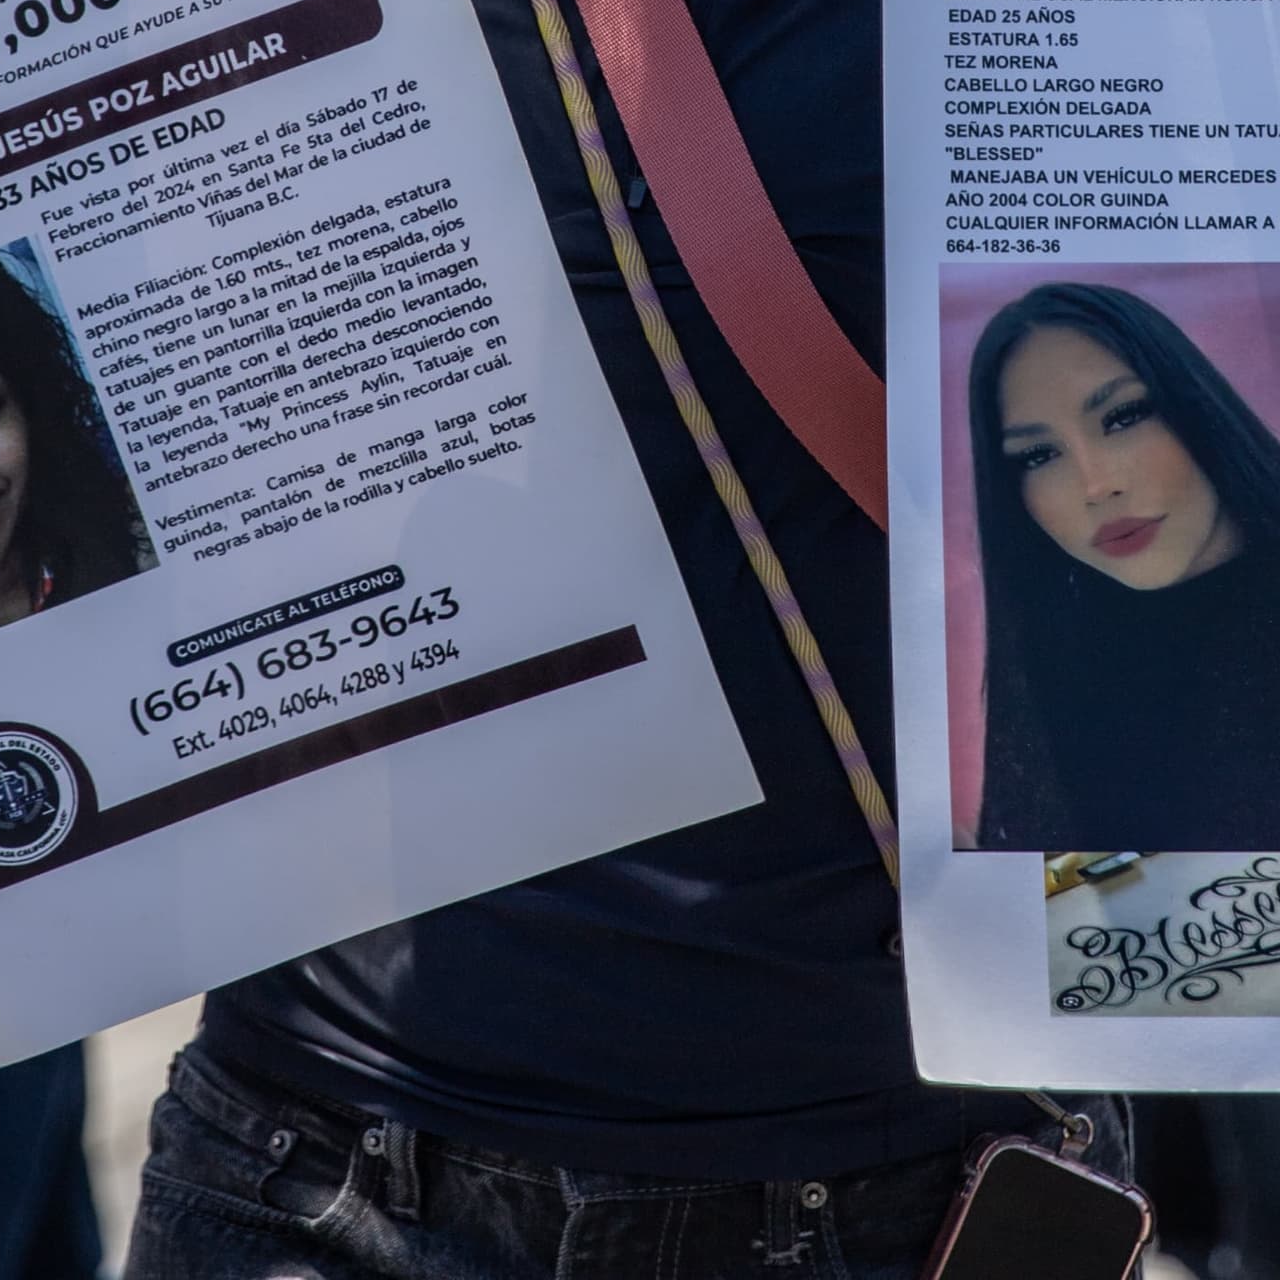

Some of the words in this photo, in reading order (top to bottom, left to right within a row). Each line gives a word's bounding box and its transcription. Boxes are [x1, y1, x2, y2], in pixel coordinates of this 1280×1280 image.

[94, 25, 129, 50] QUE
[132, 5, 185, 36] AYUDE
[188, 1, 200, 15] A
[948, 8, 997, 23] EDAD
[1001, 9, 1021, 24] 25
[1024, 5, 1076, 24] AÑOS
[948, 31, 1040, 46] ESTATURA
[1045, 32, 1078, 46] 1.65
[87, 79, 155, 121] POZ
[161, 32, 287, 97] AGUILAR
[943, 54, 977, 69] TEZ
[981, 54, 1058, 69] MORENA
[943, 77, 1028, 92] CABELLO
[1032, 77, 1095, 92] LARGO
[1099, 77, 1164, 93] NEGRO
[943, 96, 1060, 115] COMPLEXIÓN
[1065, 100, 1152, 115] DELGADA
[29, 151, 105, 198] AÑOS
[107, 134, 150, 166] DE
[151, 107, 225, 150] EDAD
[39, 205, 74, 225] Fue
[78, 187, 121, 209] vista
[126, 173, 155, 196] por
[162, 152, 216, 179] última
[219, 139, 249, 158] vez
[253, 128, 270, 146] el
[275, 120, 301, 139] día
[305, 97, 367, 128] Sábado
[370, 85, 388, 103] 17
[395, 78, 418, 95] de
[944, 190, 984, 207] AÑO
[988, 192, 1028, 207] 2004
[1032, 192, 1095, 207] COLOR
[1099, 192, 1169, 207] GUINDA
[945, 238, 1060, 253] 664-182-36-36
[176, 609, 285, 658] COMUNÍCATE
[288, 600, 308, 617] AL
[310, 570, 401, 609] TELÉFONO:
[129, 661, 245, 736] (664)
[256, 585, 460, 680] 683-9643
[171, 730, 216, 760] Ext.
[218, 705, 276, 740] 4029,
[278, 682, 338, 718] 4064,
[339, 662, 390, 696] 4288
[391, 660, 405, 685] y
[409, 638, 460, 672] 4394
[8, 739, 27, 748] DEL
[29, 742, 61, 771] ESTADO
